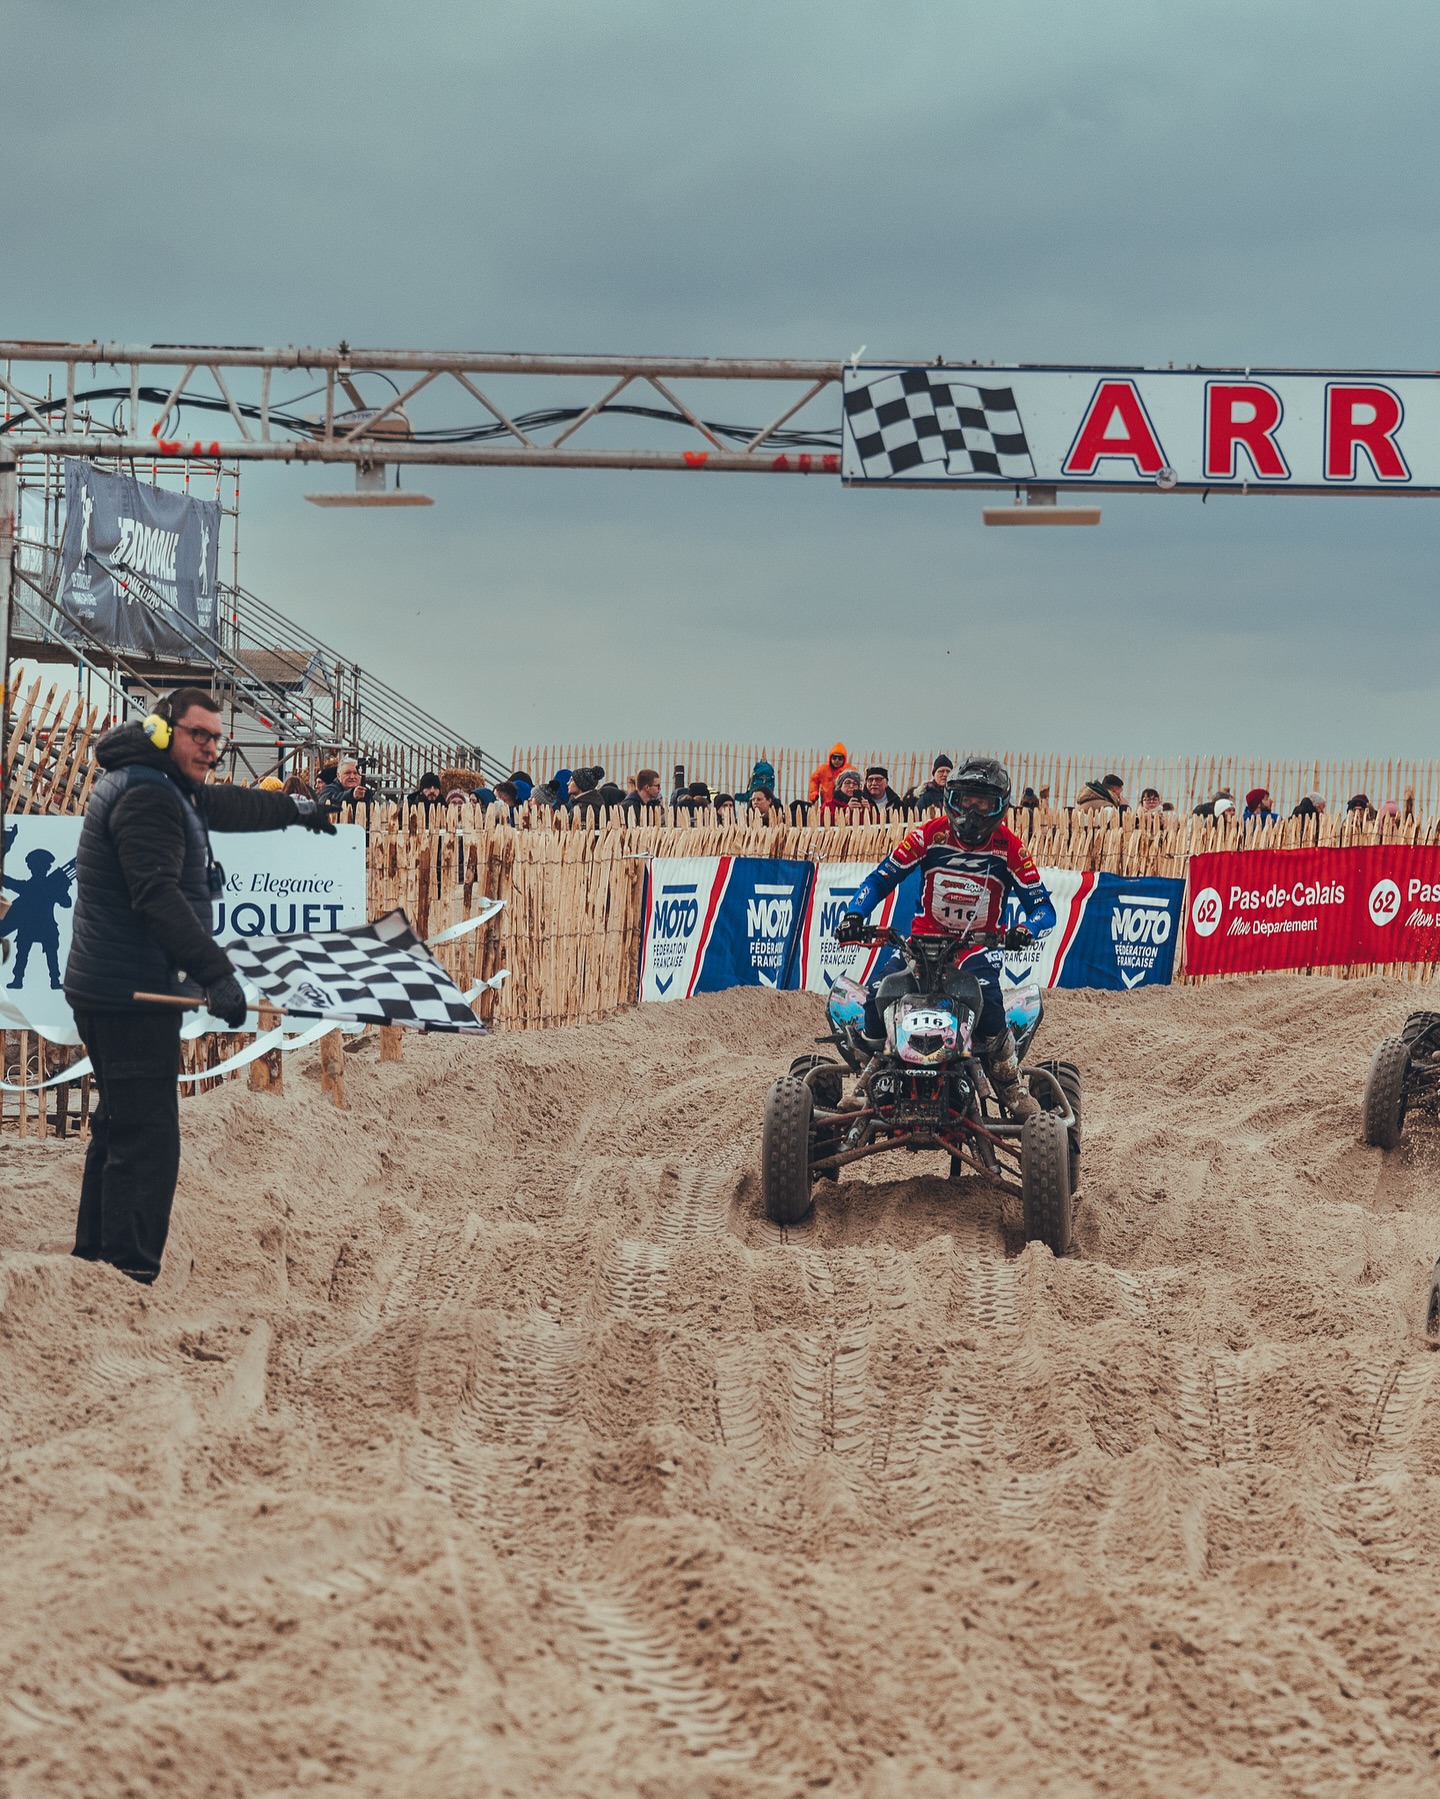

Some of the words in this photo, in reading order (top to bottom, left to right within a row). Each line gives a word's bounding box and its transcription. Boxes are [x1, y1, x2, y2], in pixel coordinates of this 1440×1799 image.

[226, 873, 243, 892] &
[250, 873, 334, 898] Elegance
[1372, 890, 1396, 913] 62
[212, 903, 344, 937] UQUET
[652, 898, 698, 939] MOTO
[746, 898, 793, 939] MOTO
[941, 907, 977, 922] 116
[1197, 899, 1217, 923] 62
[1405, 908, 1434, 926] Mon
[1111, 907, 1171, 944] MOTO
[1227, 916, 1251, 936] Mon
[1252, 917, 1318, 937] Département
[653, 940, 688, 956] FÉDÉRATION
[1115, 941, 1158, 957] FÉDÉRATION
[653, 956, 683, 970] FRANÇAISE
[820, 954, 857, 966] FRANÇAISE
[1005, 952, 1040, 964] RANÇAISE
[1117, 955, 1154, 969] FRANÇAISE
[911, 1016, 943, 1027] 116
